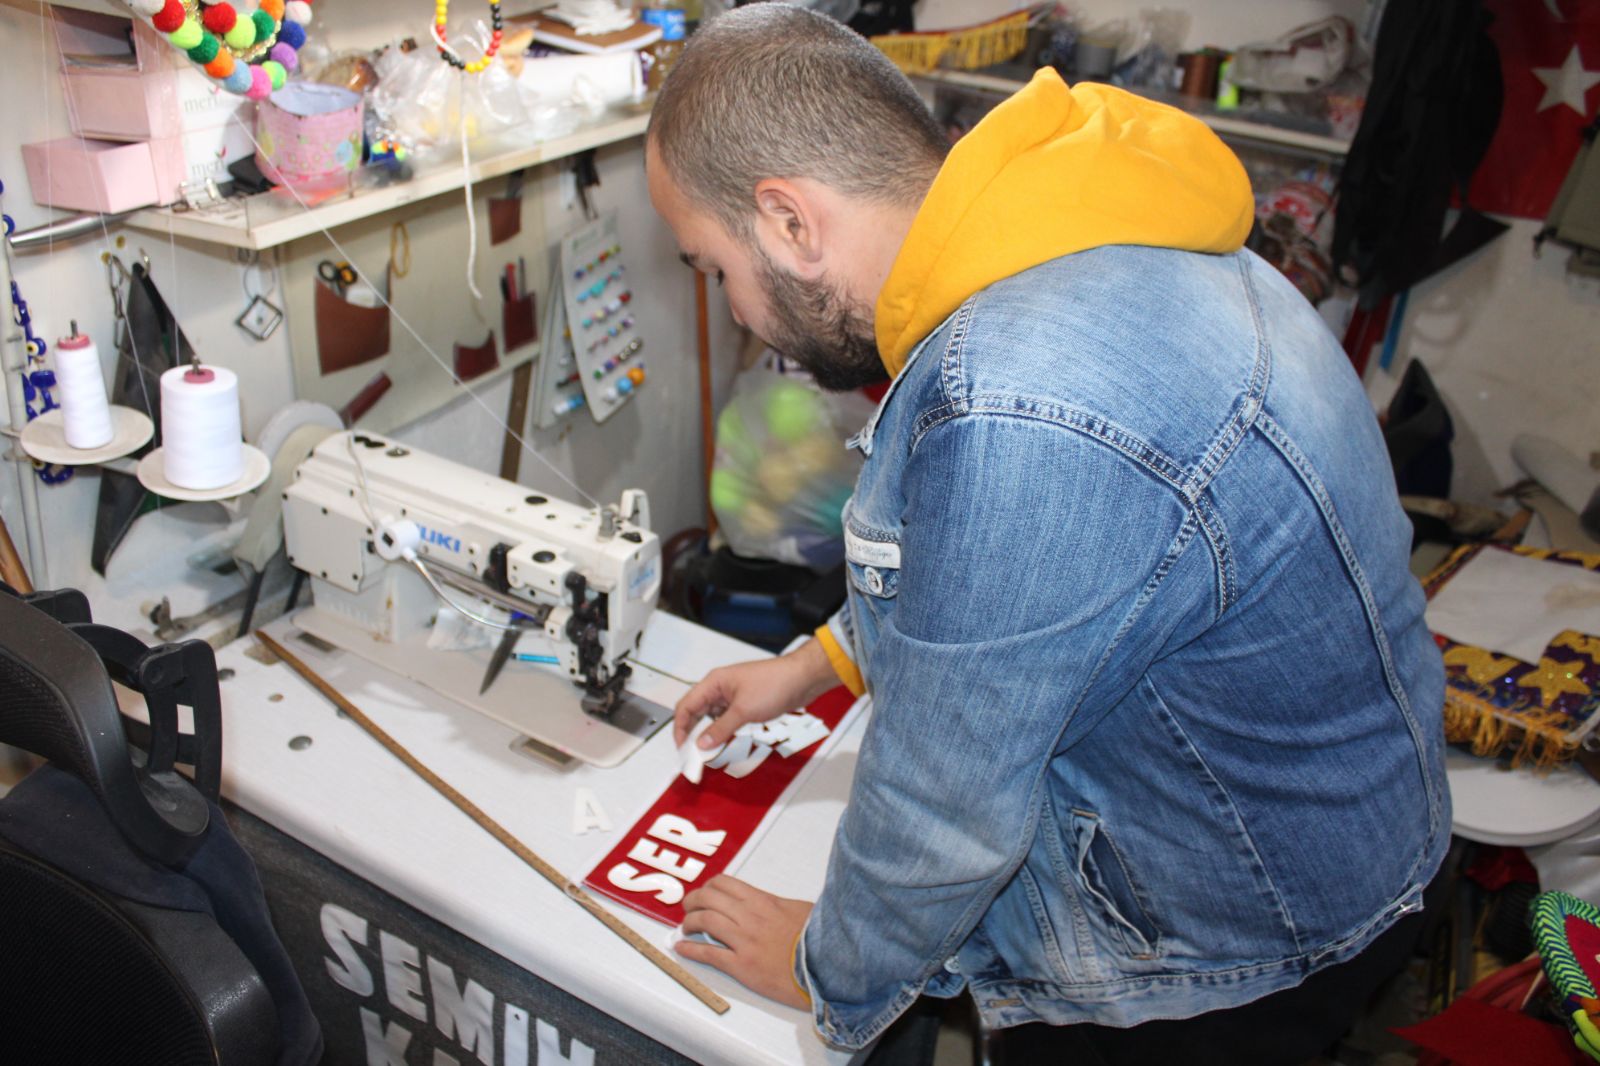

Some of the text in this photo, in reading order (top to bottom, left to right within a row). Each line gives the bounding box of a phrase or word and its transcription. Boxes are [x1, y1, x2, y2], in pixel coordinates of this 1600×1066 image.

[415, 523, 461, 554] UKI
[607, 813, 728, 905] SER
[359, 1006, 461, 1066] K
